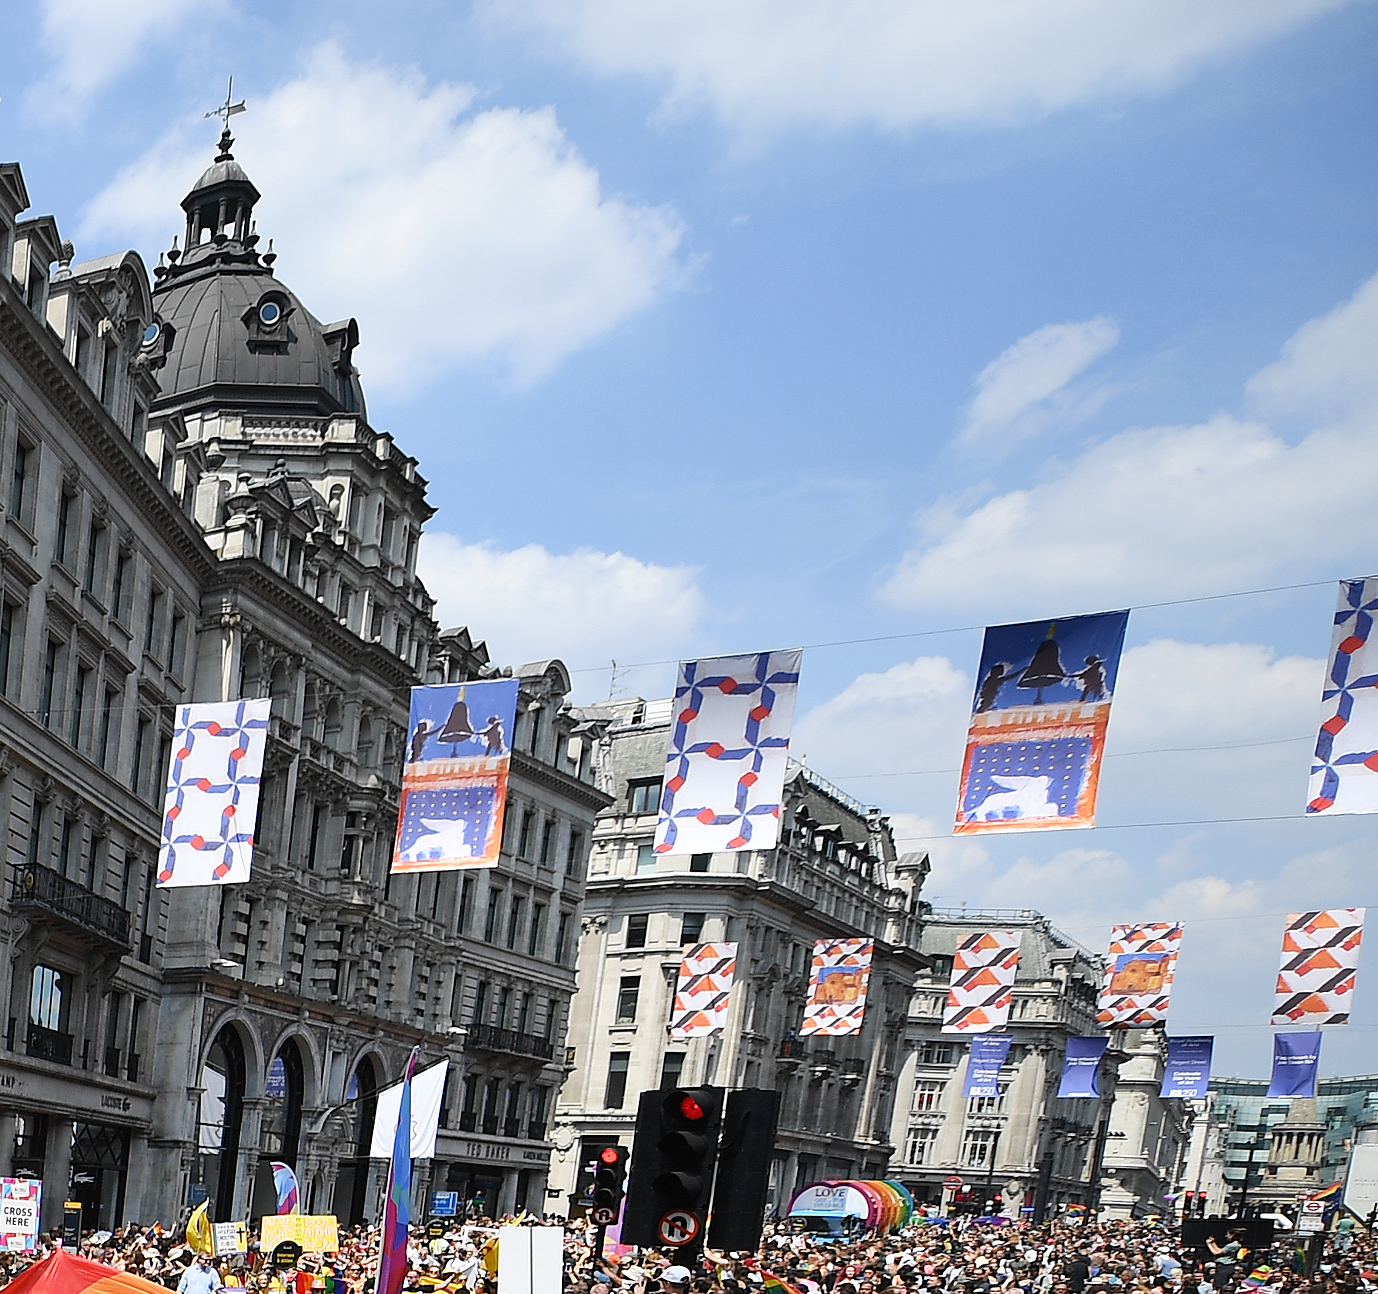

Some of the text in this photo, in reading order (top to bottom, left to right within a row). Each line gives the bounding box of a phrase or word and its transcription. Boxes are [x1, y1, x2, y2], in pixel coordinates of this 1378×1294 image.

[815, 1188, 846, 1197] LOVE
[4, 1206, 33, 1217] CROSS
[5, 1216, 30, 1227] HERE
